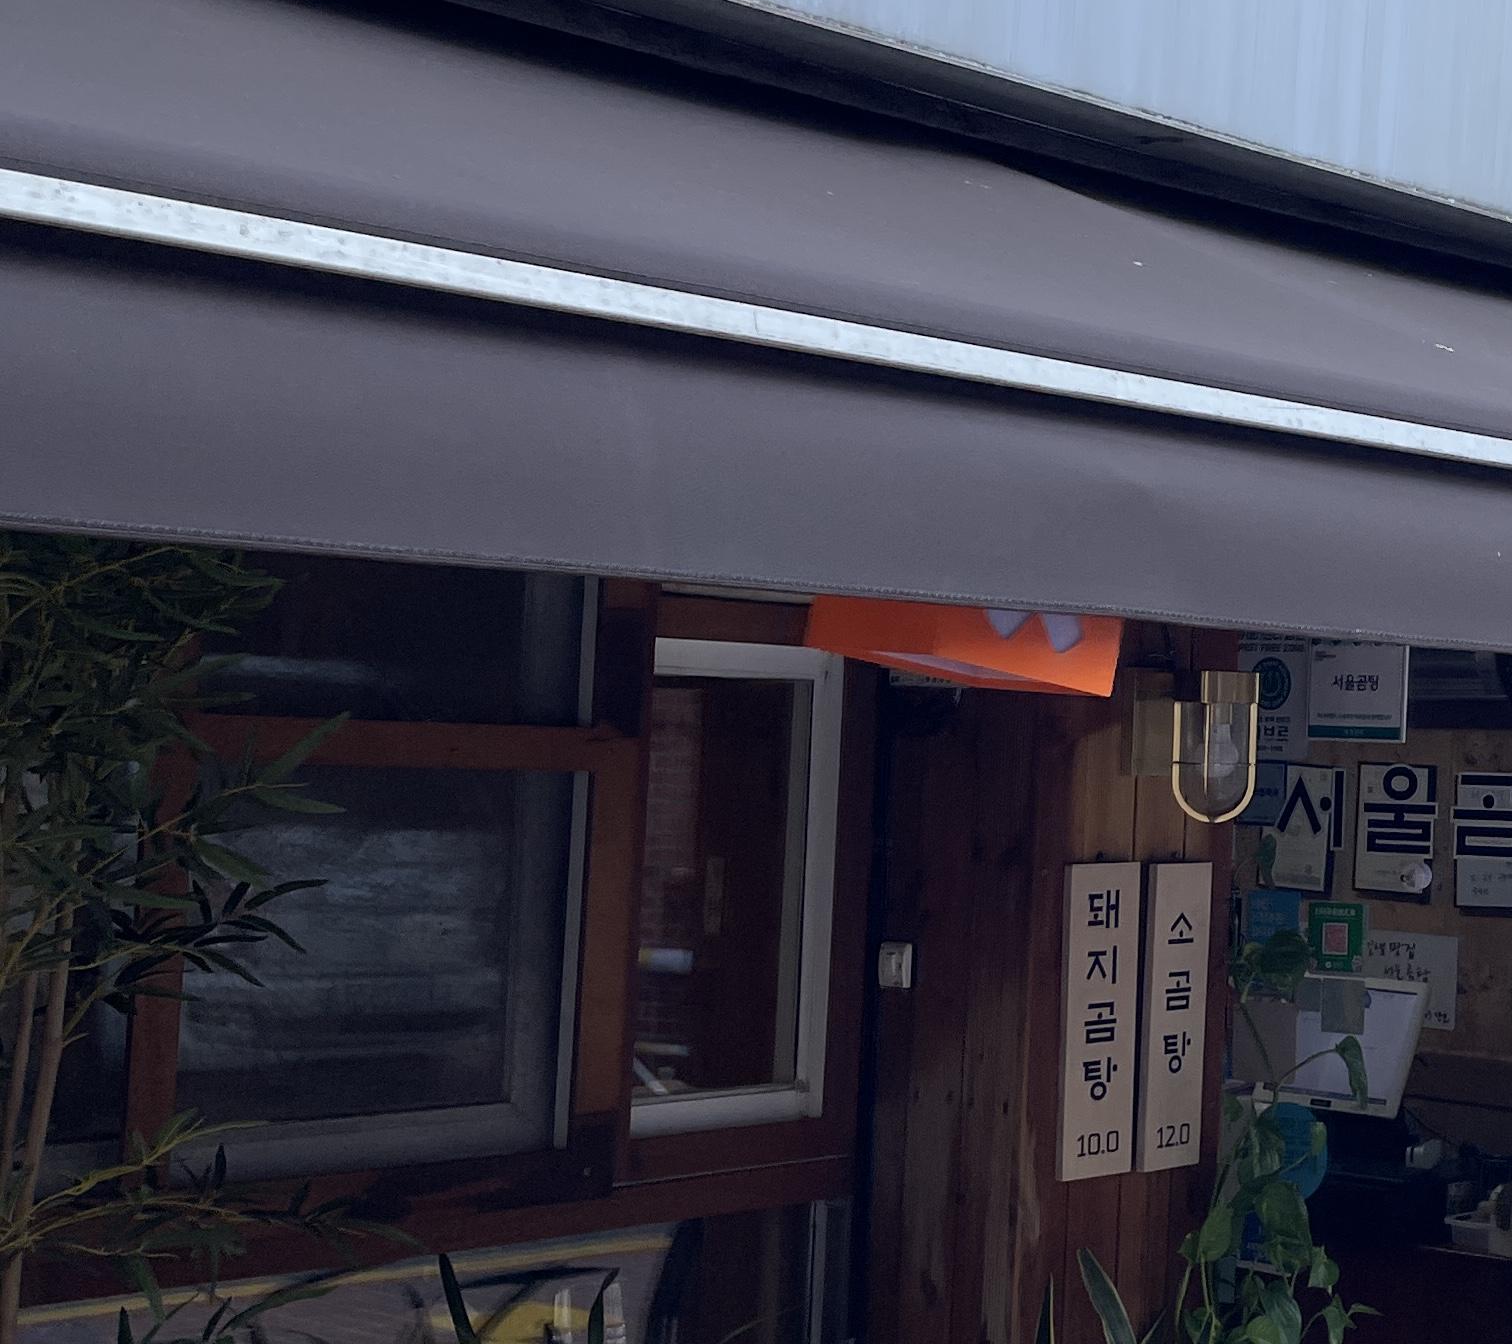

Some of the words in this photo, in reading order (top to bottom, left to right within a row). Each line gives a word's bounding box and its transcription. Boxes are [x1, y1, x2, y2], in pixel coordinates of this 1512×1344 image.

[1332, 674, 1379, 692] 서울곰탕
[1082, 888, 1121, 1101] 돼지곰탕
[1162, 912, 1194, 1074] 소곰탕
[1076, 1130, 1120, 1157] 10.0
[1156, 1122, 1191, 1149] 12.0
